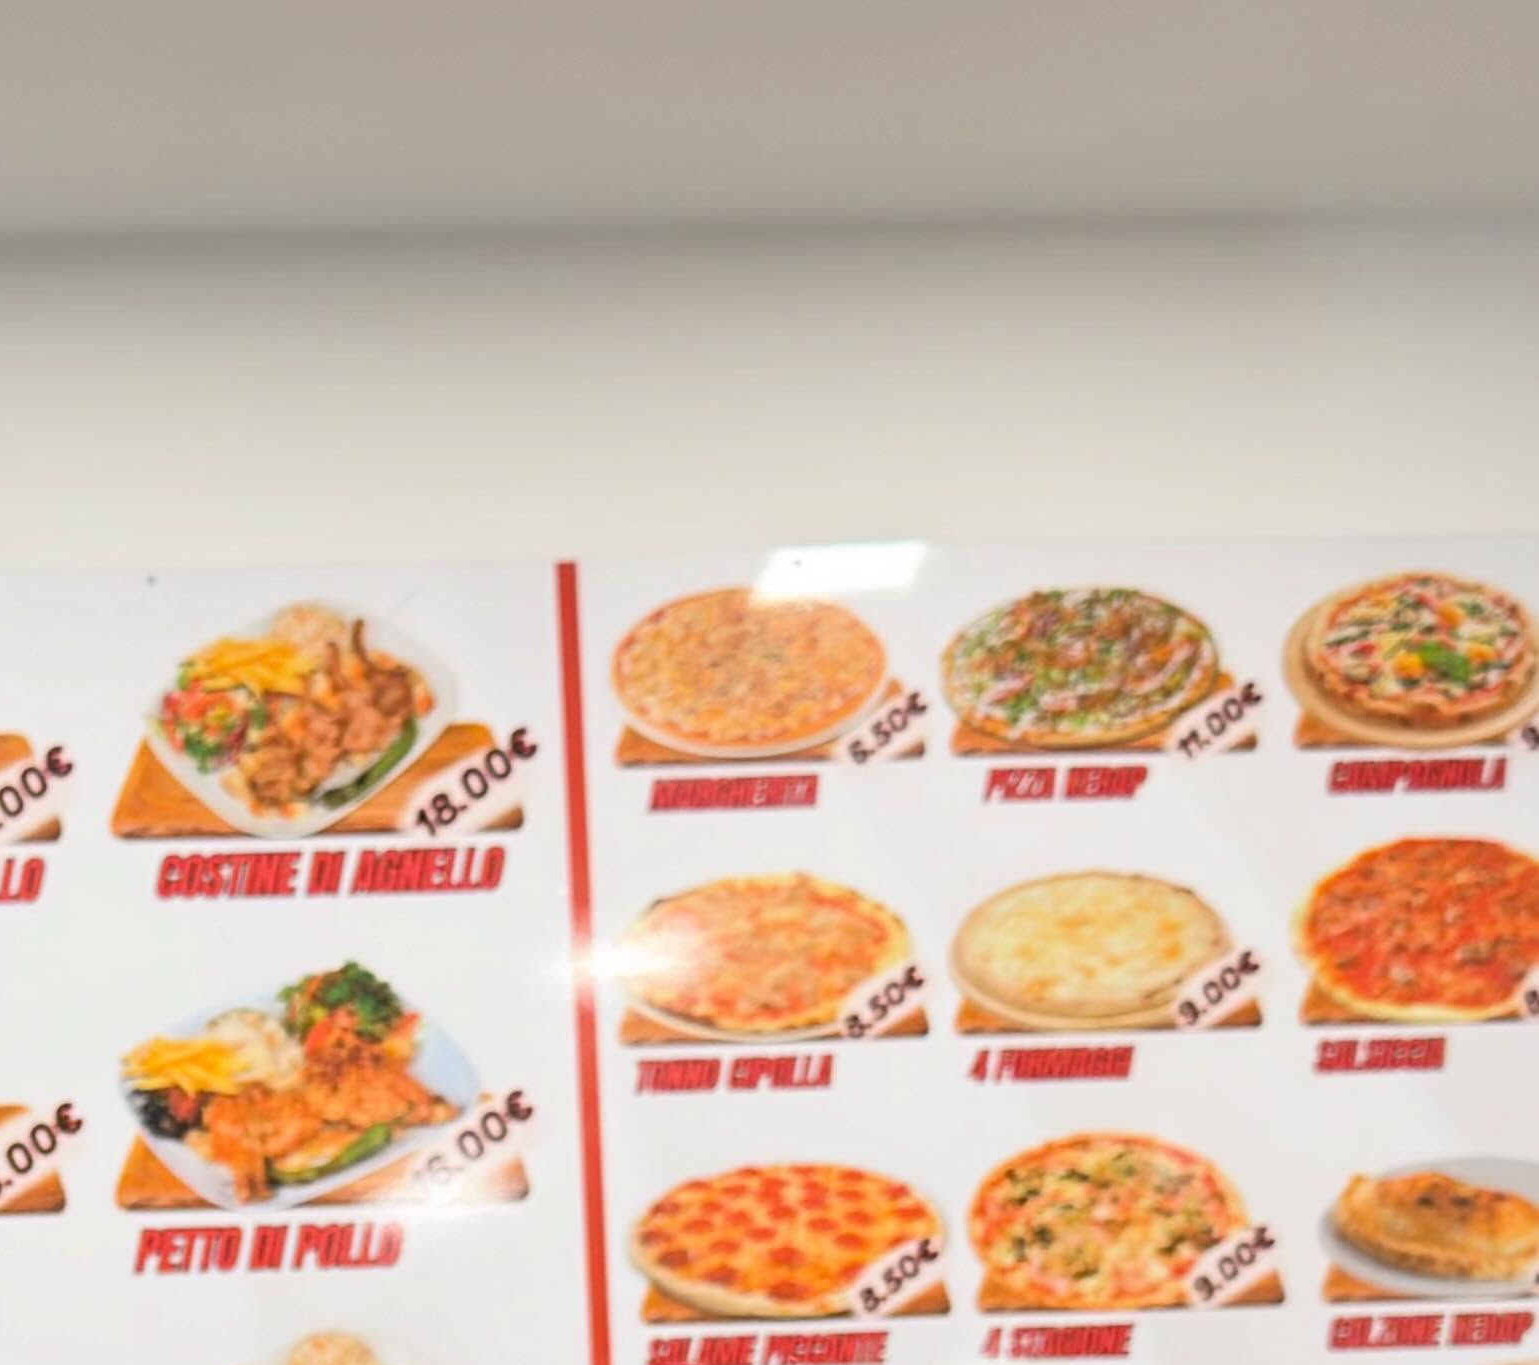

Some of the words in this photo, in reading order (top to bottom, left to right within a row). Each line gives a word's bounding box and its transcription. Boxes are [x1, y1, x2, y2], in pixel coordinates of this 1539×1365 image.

[1178, 682, 1265, 759] 11.00€
[414, 727, 539, 838] 18.00€
[156, 851, 303, 901] COSTINE
[307, 849, 347, 898] DI
[350, 844, 506, 897] AGNELLO
[133, 1226, 243, 1276] PETTO
[248, 1224, 288, 1271] DI
[292, 1221, 406, 1271] POLLO
